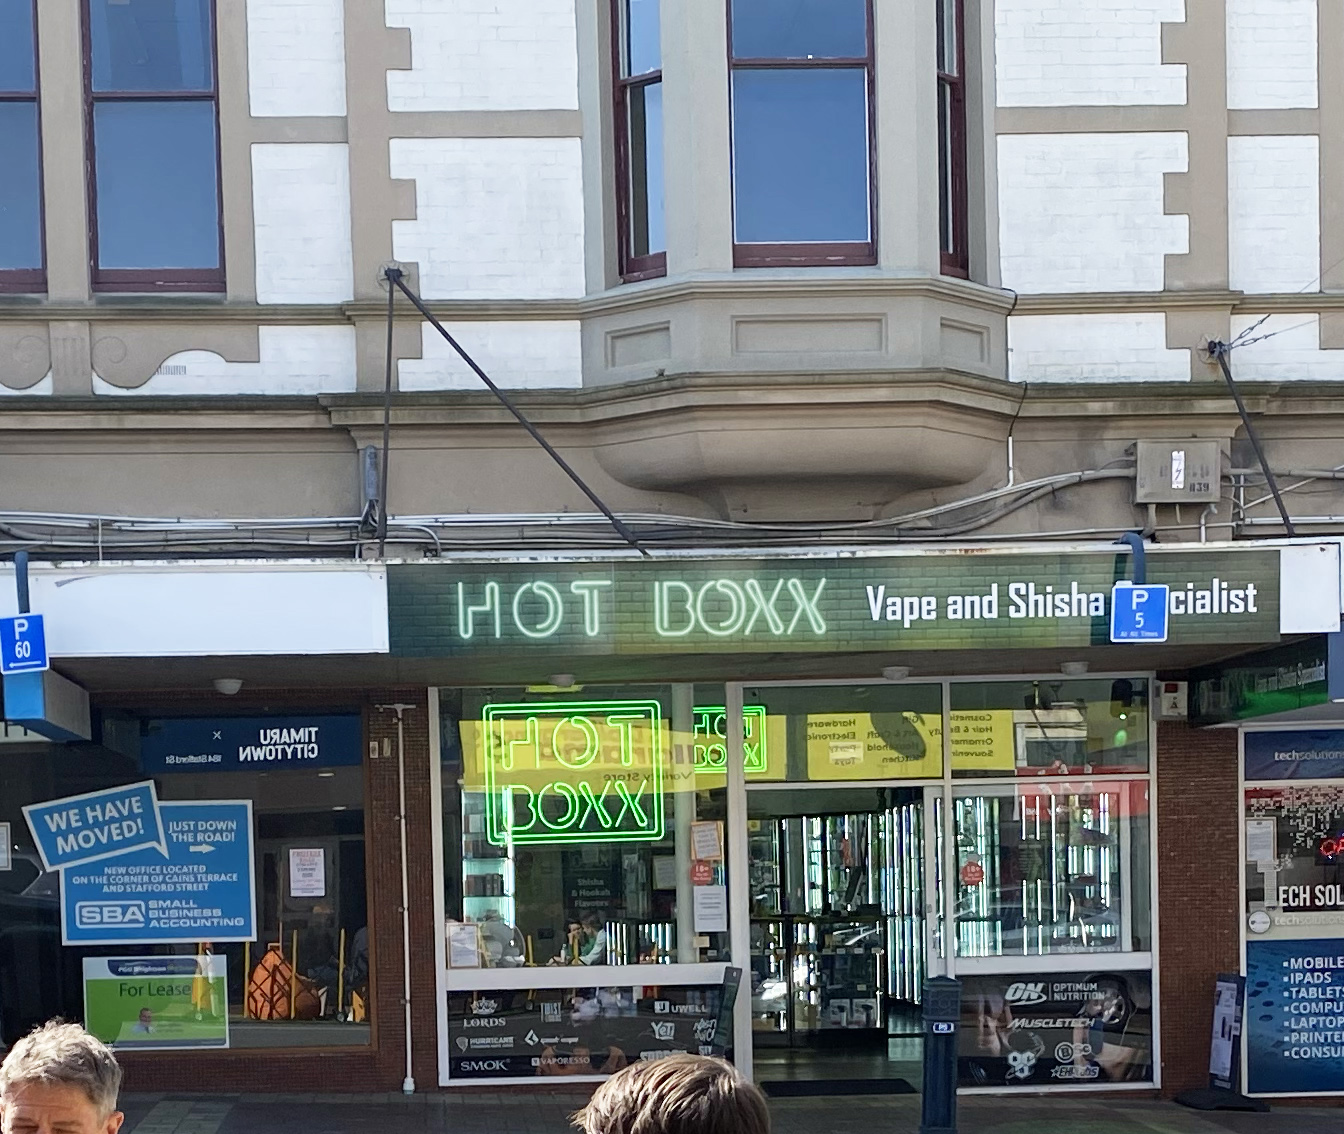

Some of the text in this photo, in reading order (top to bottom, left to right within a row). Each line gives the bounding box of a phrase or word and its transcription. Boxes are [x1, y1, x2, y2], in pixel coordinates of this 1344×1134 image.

[866, 577, 1258, 628] Vape and Shisha cialist
[1131, 589, 1149, 610] P
[457, 576, 829, 640] HOT BOXX
[1134, 612, 1144, 629] 5
[13, 618, 29, 641] P
[14, 641, 31, 659] 60
[499, 714, 646, 771] HOT
[503, 779, 649, 832] BOXX
[44, 796, 144, 833] WE HAVE
[168, 820, 237, 835] JUST DOWN
[56, 817, 145, 856] MOVED!
[171, 831, 235, 843] THE ROAD!
[104, 864, 206, 875] NEW OFFICE LOCATED
[72, 873, 238, 885] ON THE CORNER OF CAINS TERRACE
[102, 882, 210, 894] AND STAFFORD STREET
[148, 899, 198, 909] SMALL
[80, 905, 145, 924] SBA
[148, 908, 222, 919] BUSINESS
[148, 917, 245, 929] ACCOUNTING
[1290, 971, 1332, 985] IPADS
[119, 982, 192, 998] For Lease
[1005, 982, 1098, 1001] ON OPTIMUM
[1053, 991, 1105, 1001] NUTRITION
[463, 1017, 506, 1028] LORDS
[1007, 1017, 1096, 1029] MUSCLETECH
[460, 1060, 508, 1072] SMOK
